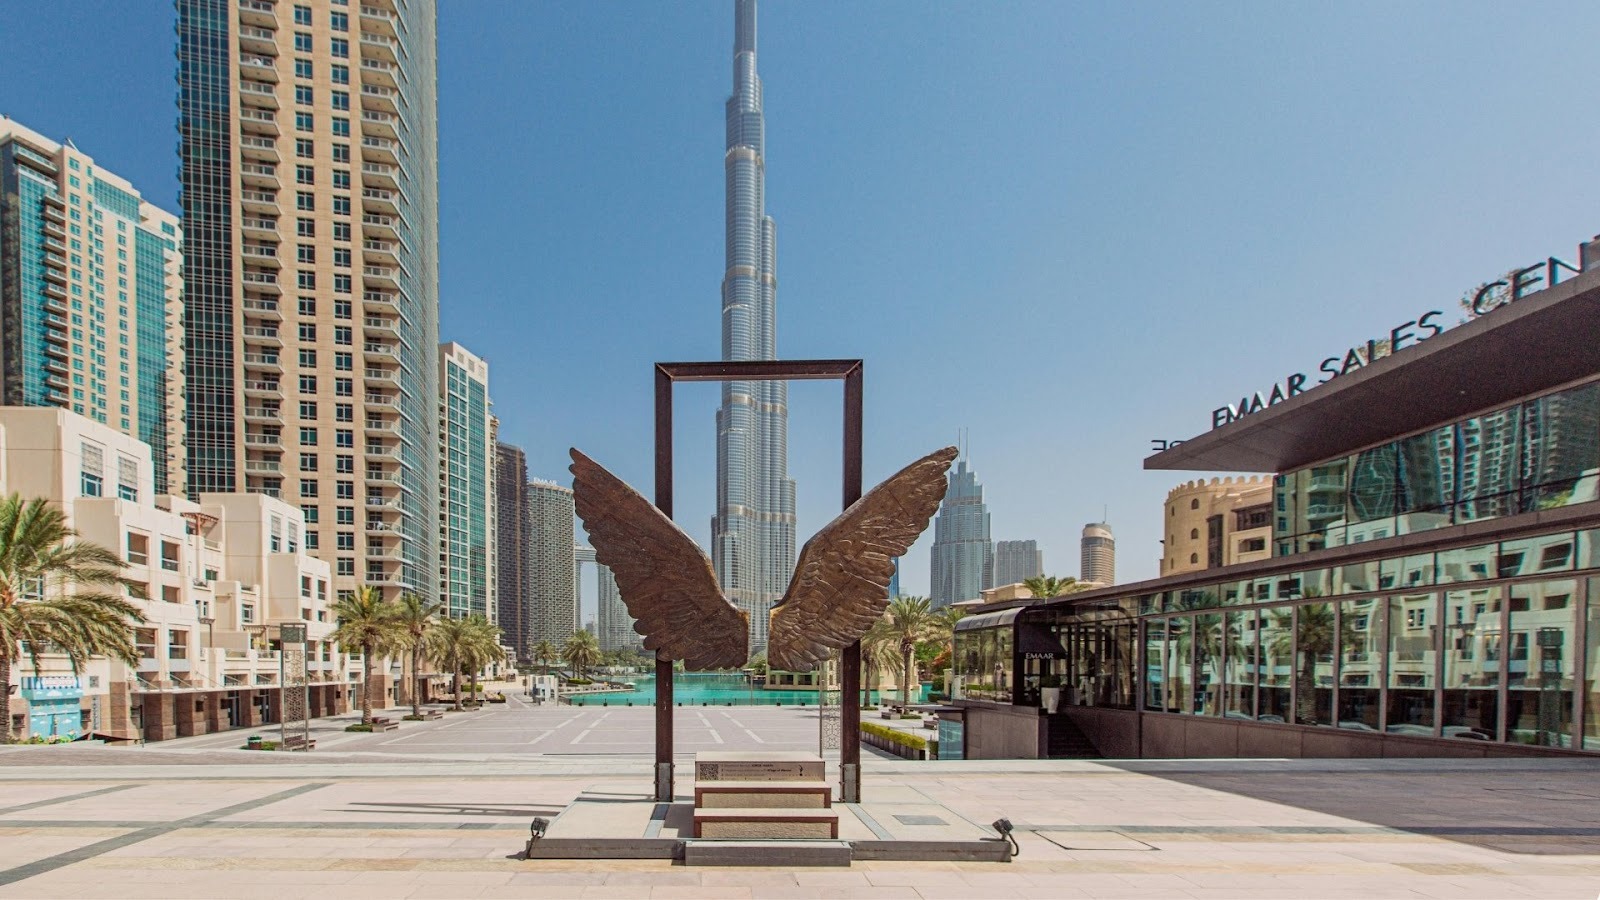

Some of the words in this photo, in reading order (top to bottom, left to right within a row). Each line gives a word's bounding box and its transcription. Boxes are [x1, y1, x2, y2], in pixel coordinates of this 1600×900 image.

[1212, 373, 1306, 430] EMAAR
[1318, 310, 1443, 384] SALES
[1473, 234, 1600, 315] CEN
